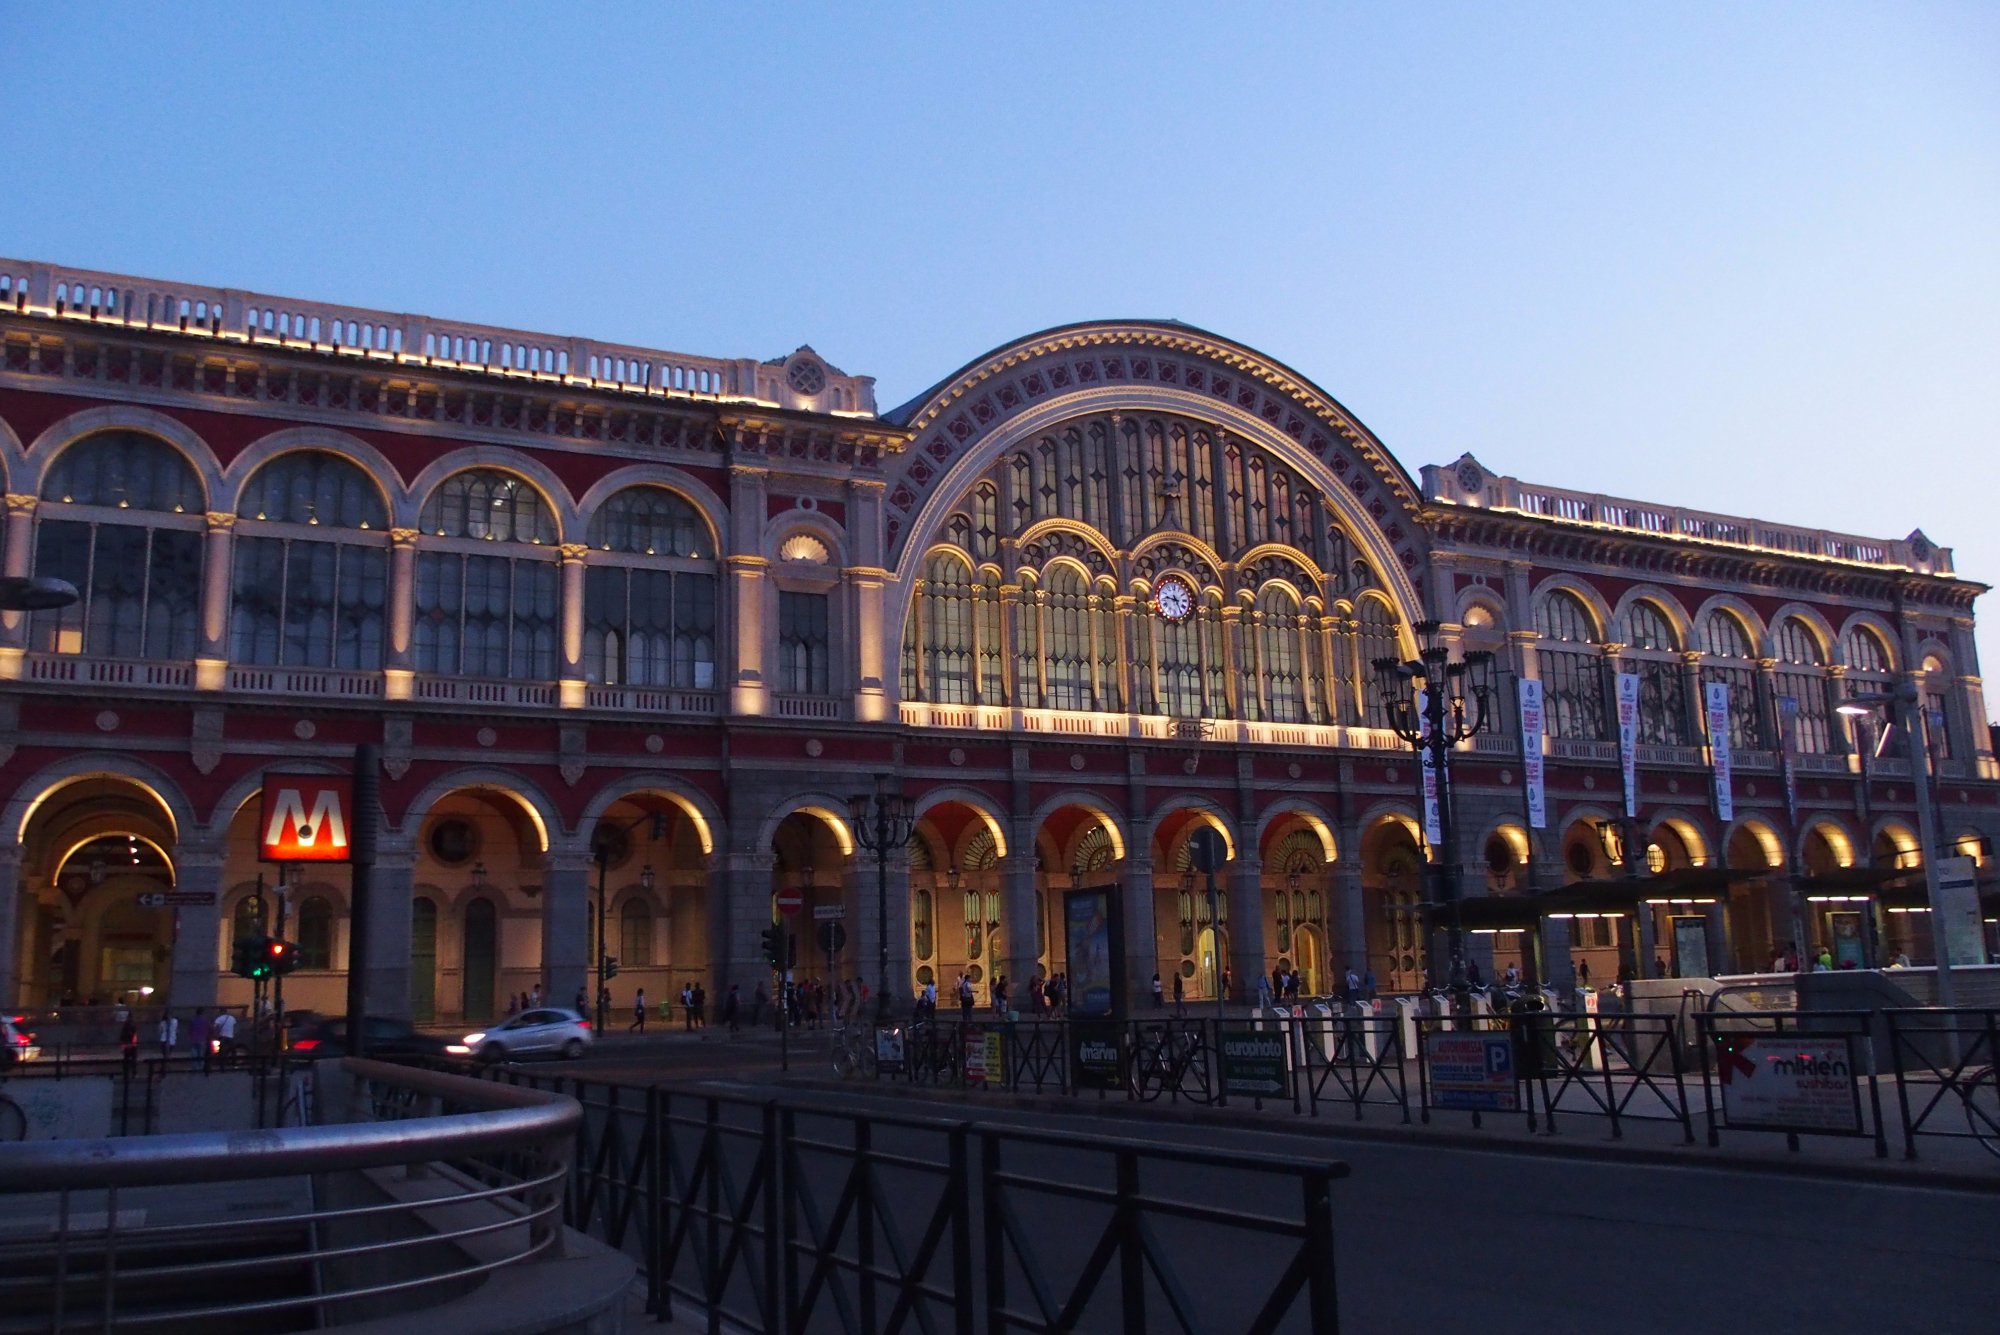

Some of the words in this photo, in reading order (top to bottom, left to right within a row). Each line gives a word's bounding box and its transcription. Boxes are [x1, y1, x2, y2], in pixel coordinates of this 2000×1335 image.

[266, 789, 348, 847] M
[1085, 1047, 1117, 1060] marvin
[1225, 1037, 1282, 1057] europhoto
[1490, 1046, 1506, 1072] P
[1796, 1077, 1849, 1089] sushibar
